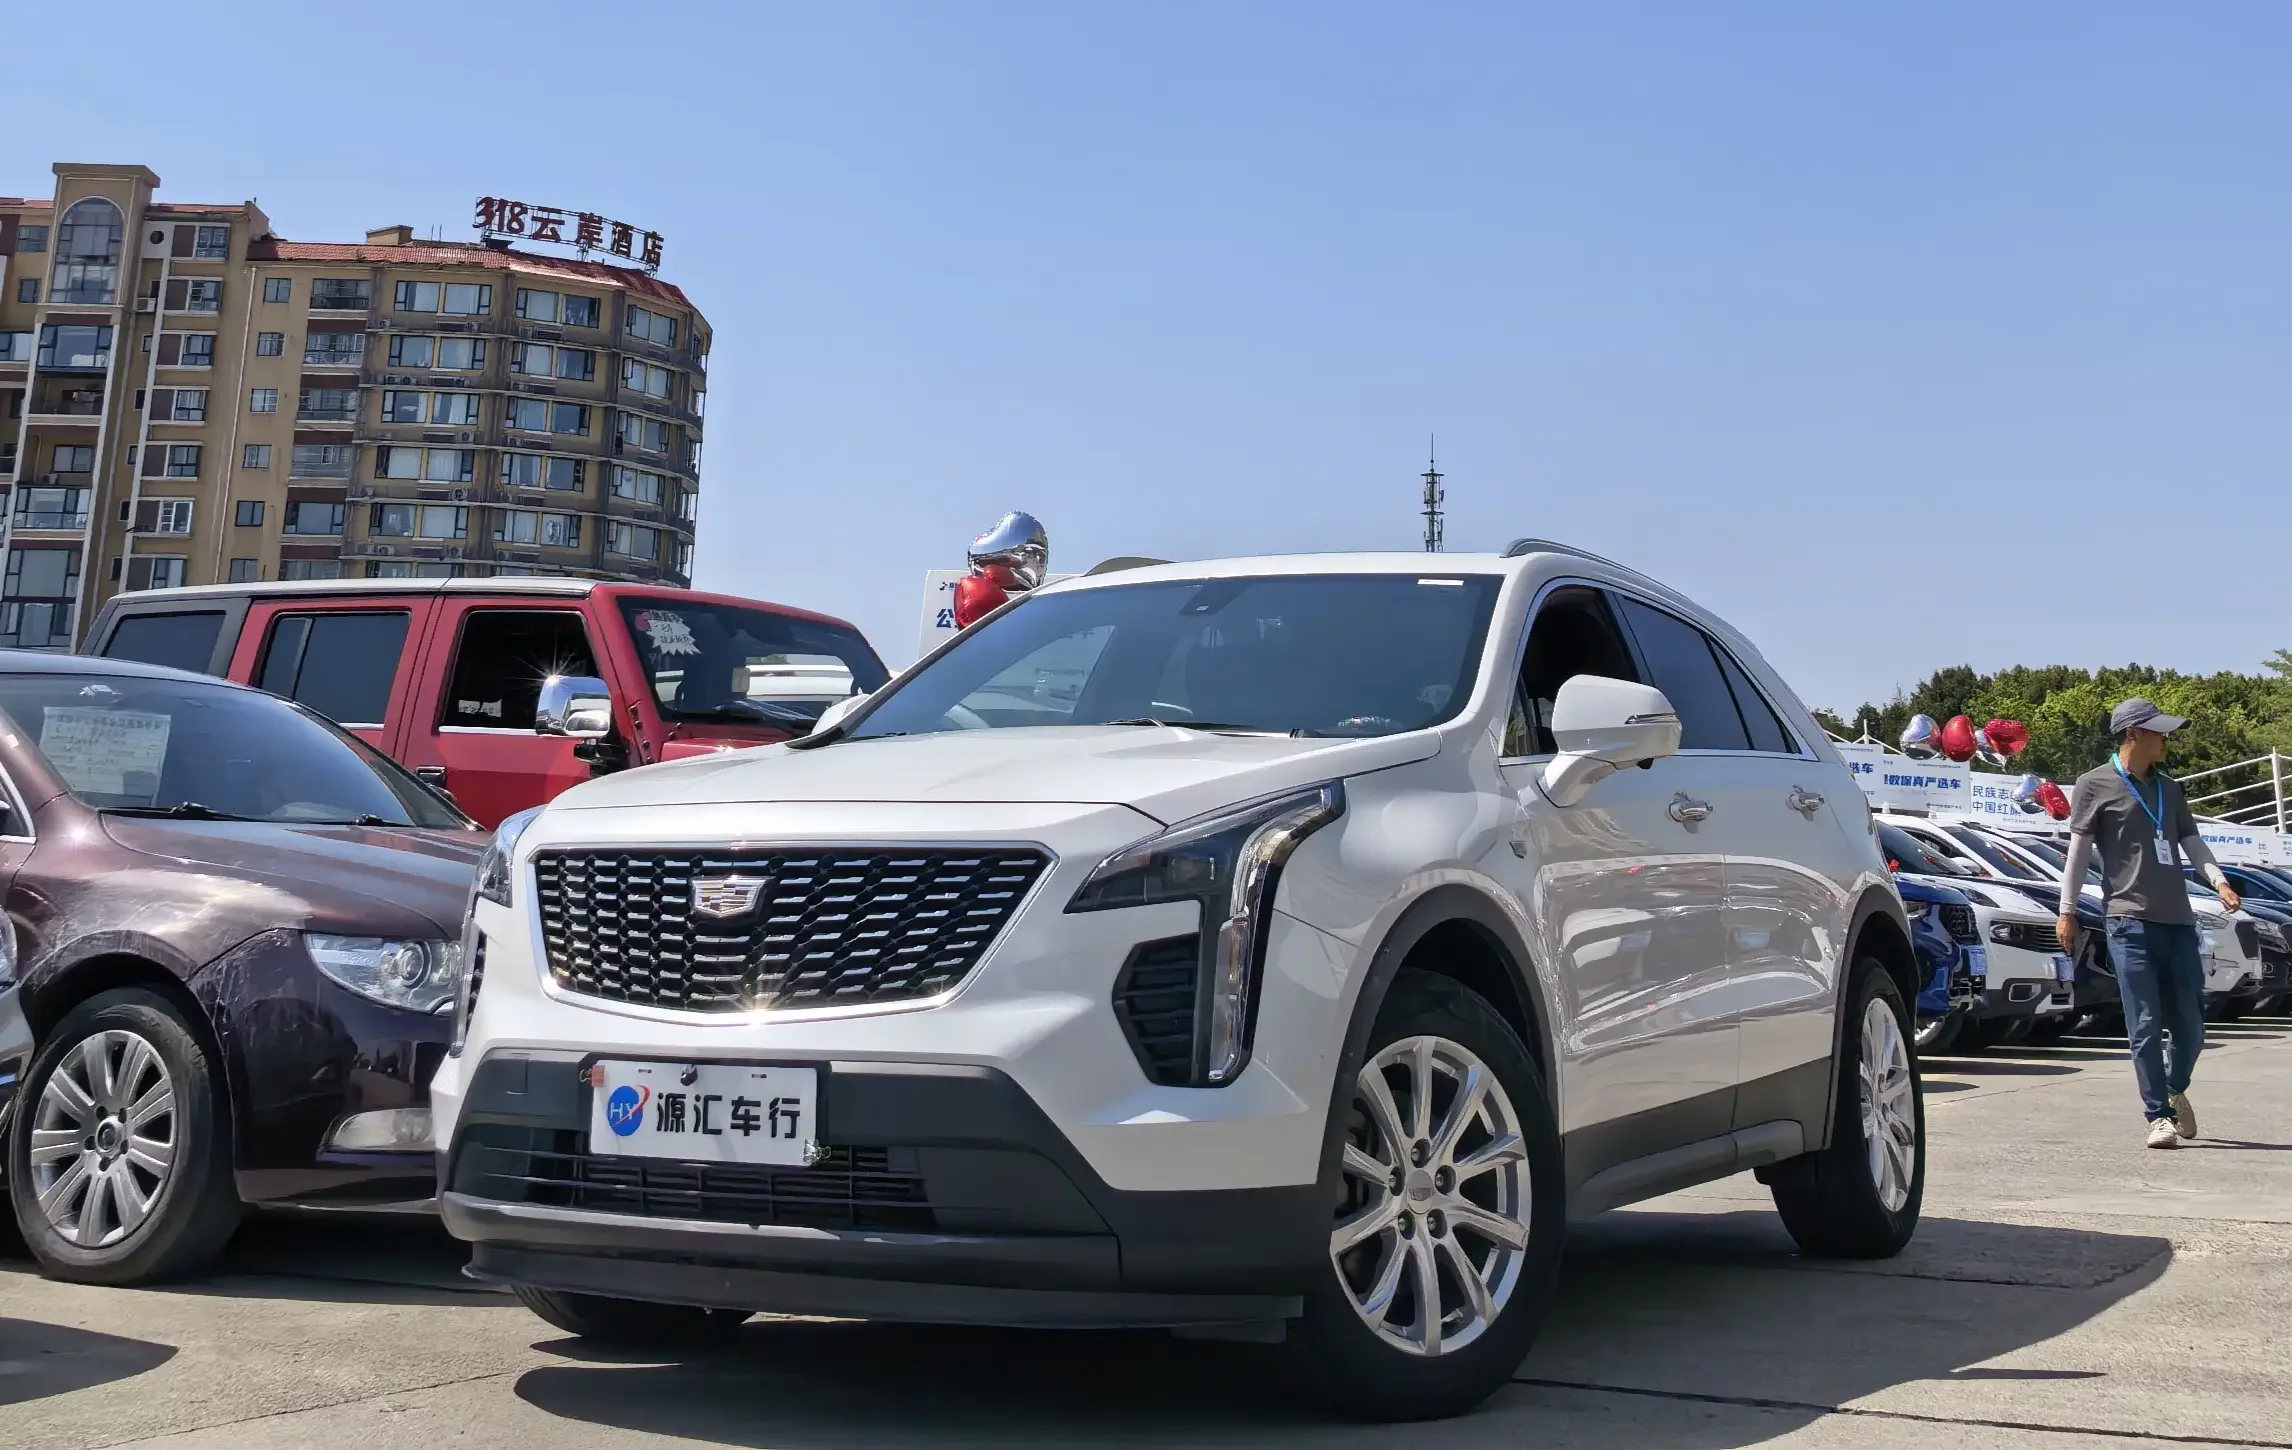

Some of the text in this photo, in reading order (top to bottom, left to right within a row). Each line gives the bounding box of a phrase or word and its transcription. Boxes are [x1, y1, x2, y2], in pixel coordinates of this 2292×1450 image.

[472, 196, 665, 267] 318云岸酒店
[937, 608, 957, 629] 公
[610, 1092, 801, 1139] HY 源汇车行
